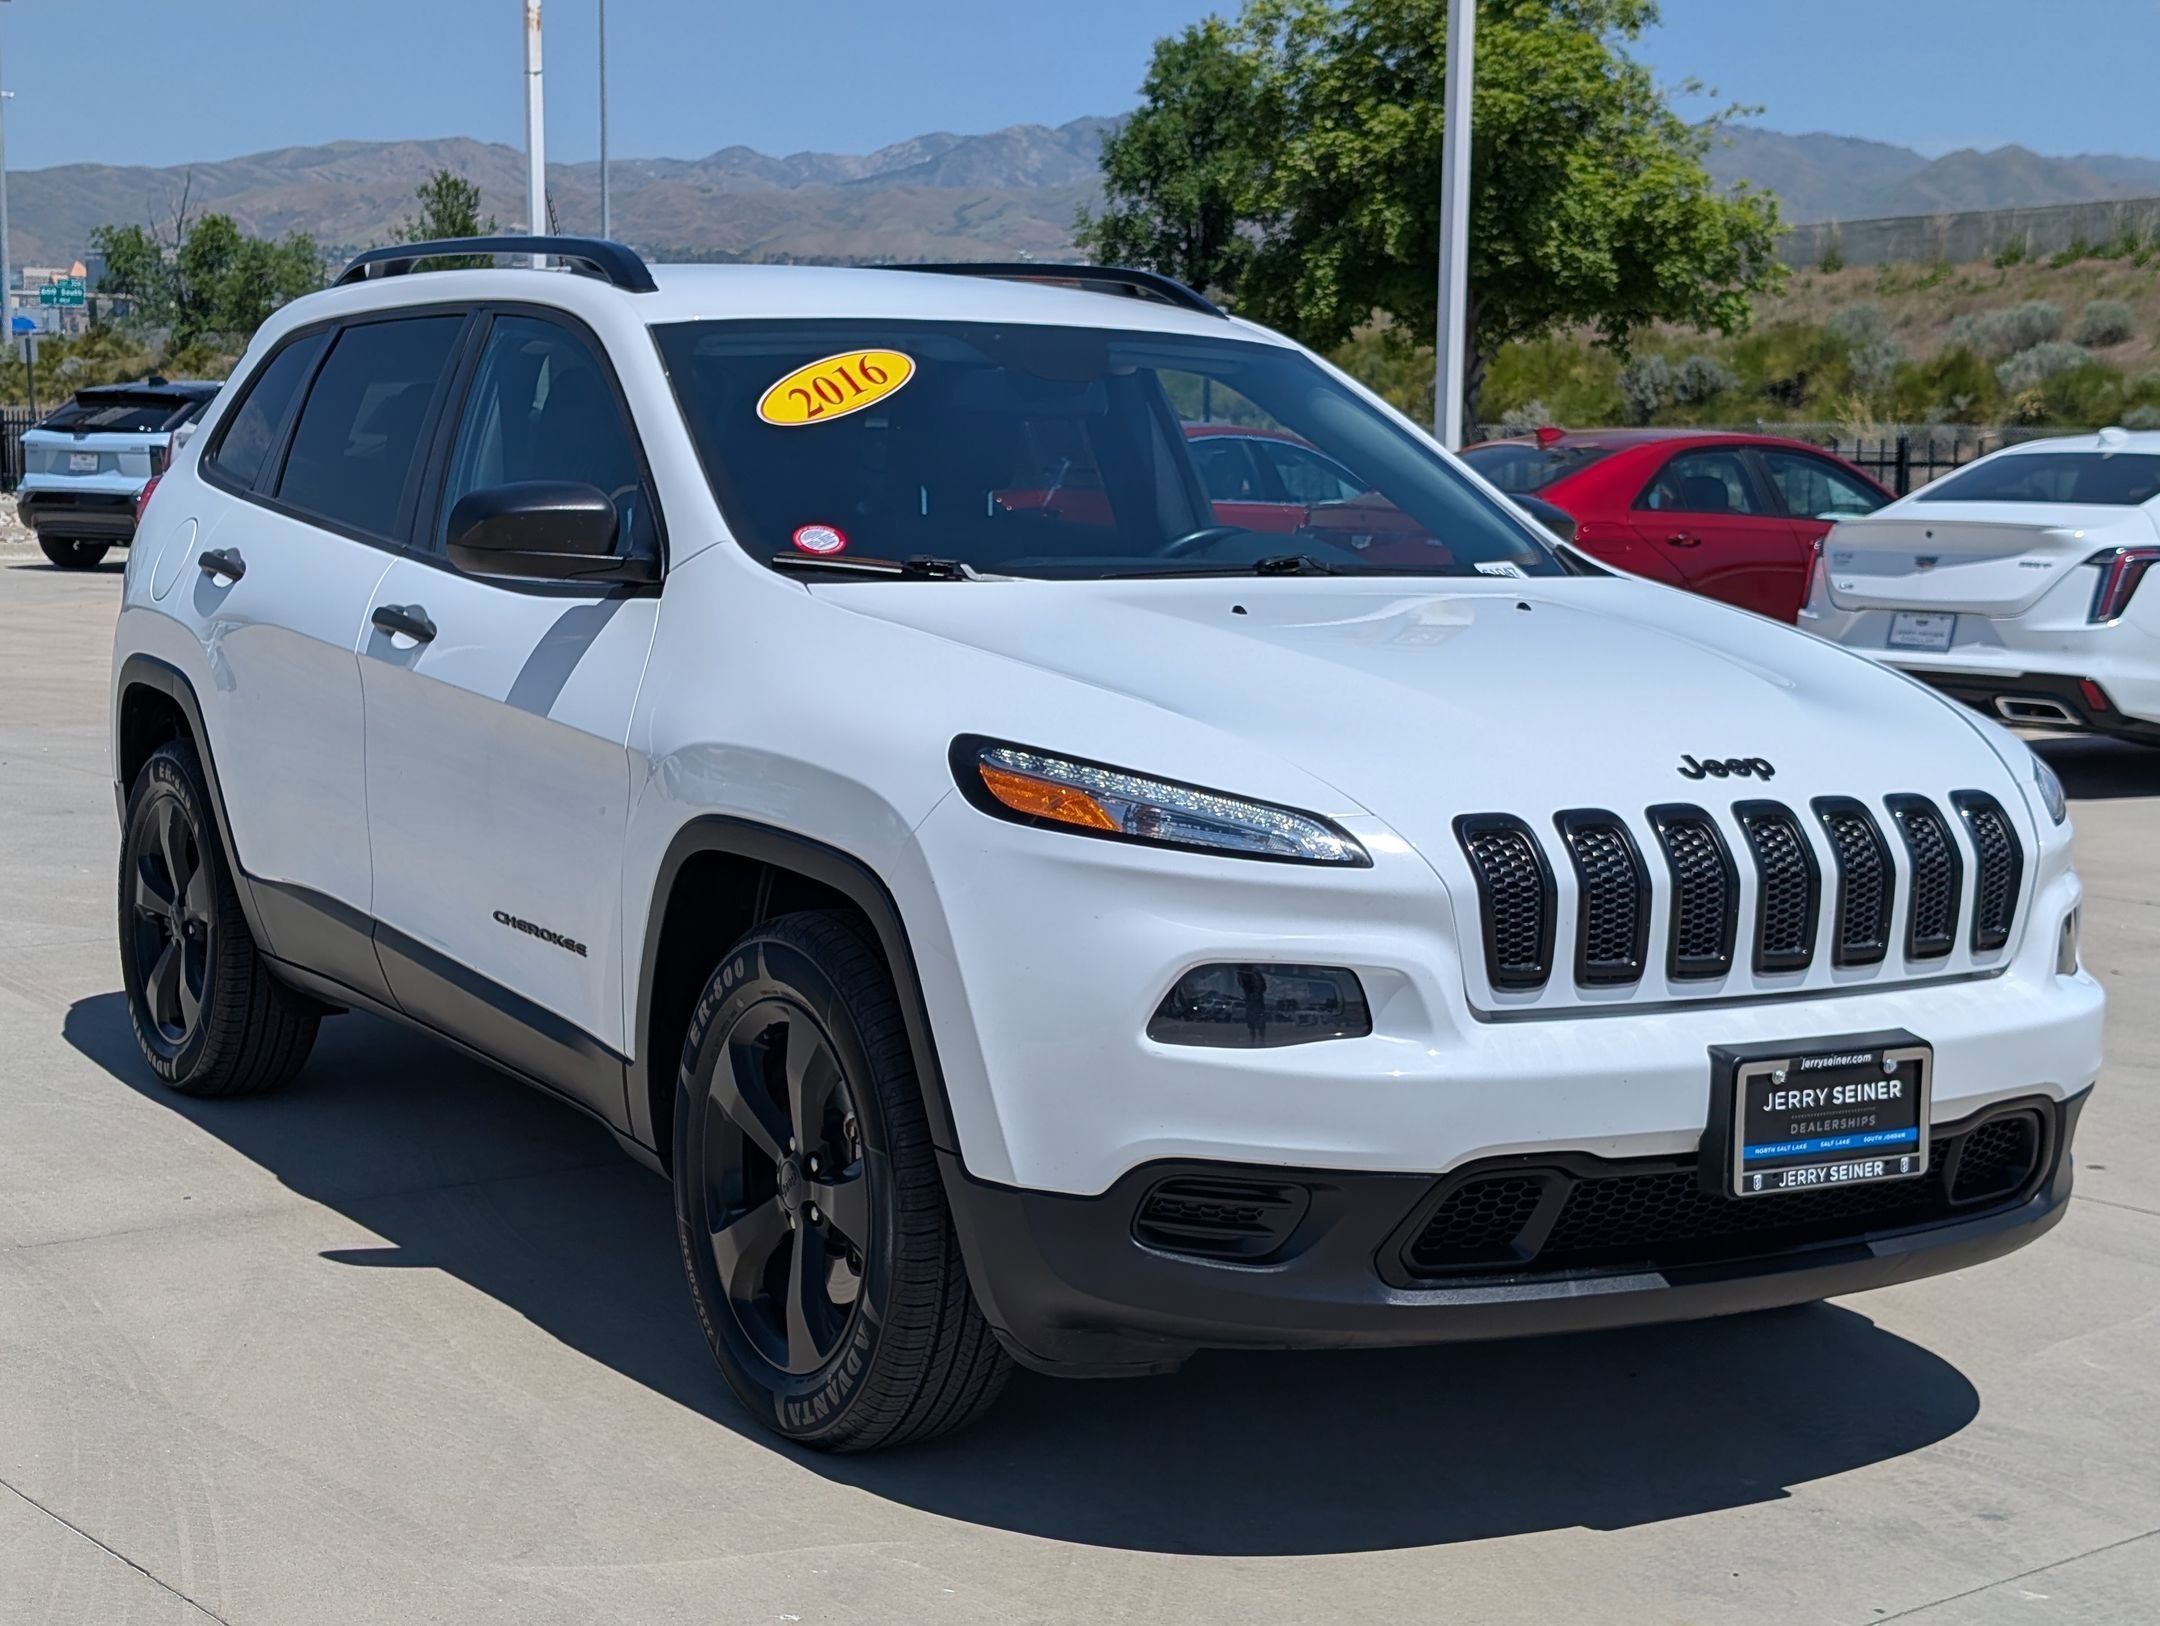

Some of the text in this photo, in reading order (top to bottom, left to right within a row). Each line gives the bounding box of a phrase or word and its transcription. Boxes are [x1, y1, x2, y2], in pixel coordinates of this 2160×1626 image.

[788, 355, 888, 418] 2016
[1677, 755, 1776, 781] Jeep
[493, 910, 587, 958] CHEROKEE
[689, 956, 745, 1048] ER-800
[1801, 1053, 1872, 1070] jerryseiner.com
[1763, 1079, 1902, 1112] JERRY SEINER
[1790, 1115, 1876, 1135] DEALERSHIPS
[1755, 1143, 1807, 1155] NORTH SALT LAKE
[1820, 1138, 1850, 1148] SALT LAKE
[1863, 1135, 1883, 1143] SOUTH
[1779, 1161, 1884, 1188] JERRY SEINER
[787, 1319, 871, 1427] ADVANTA
